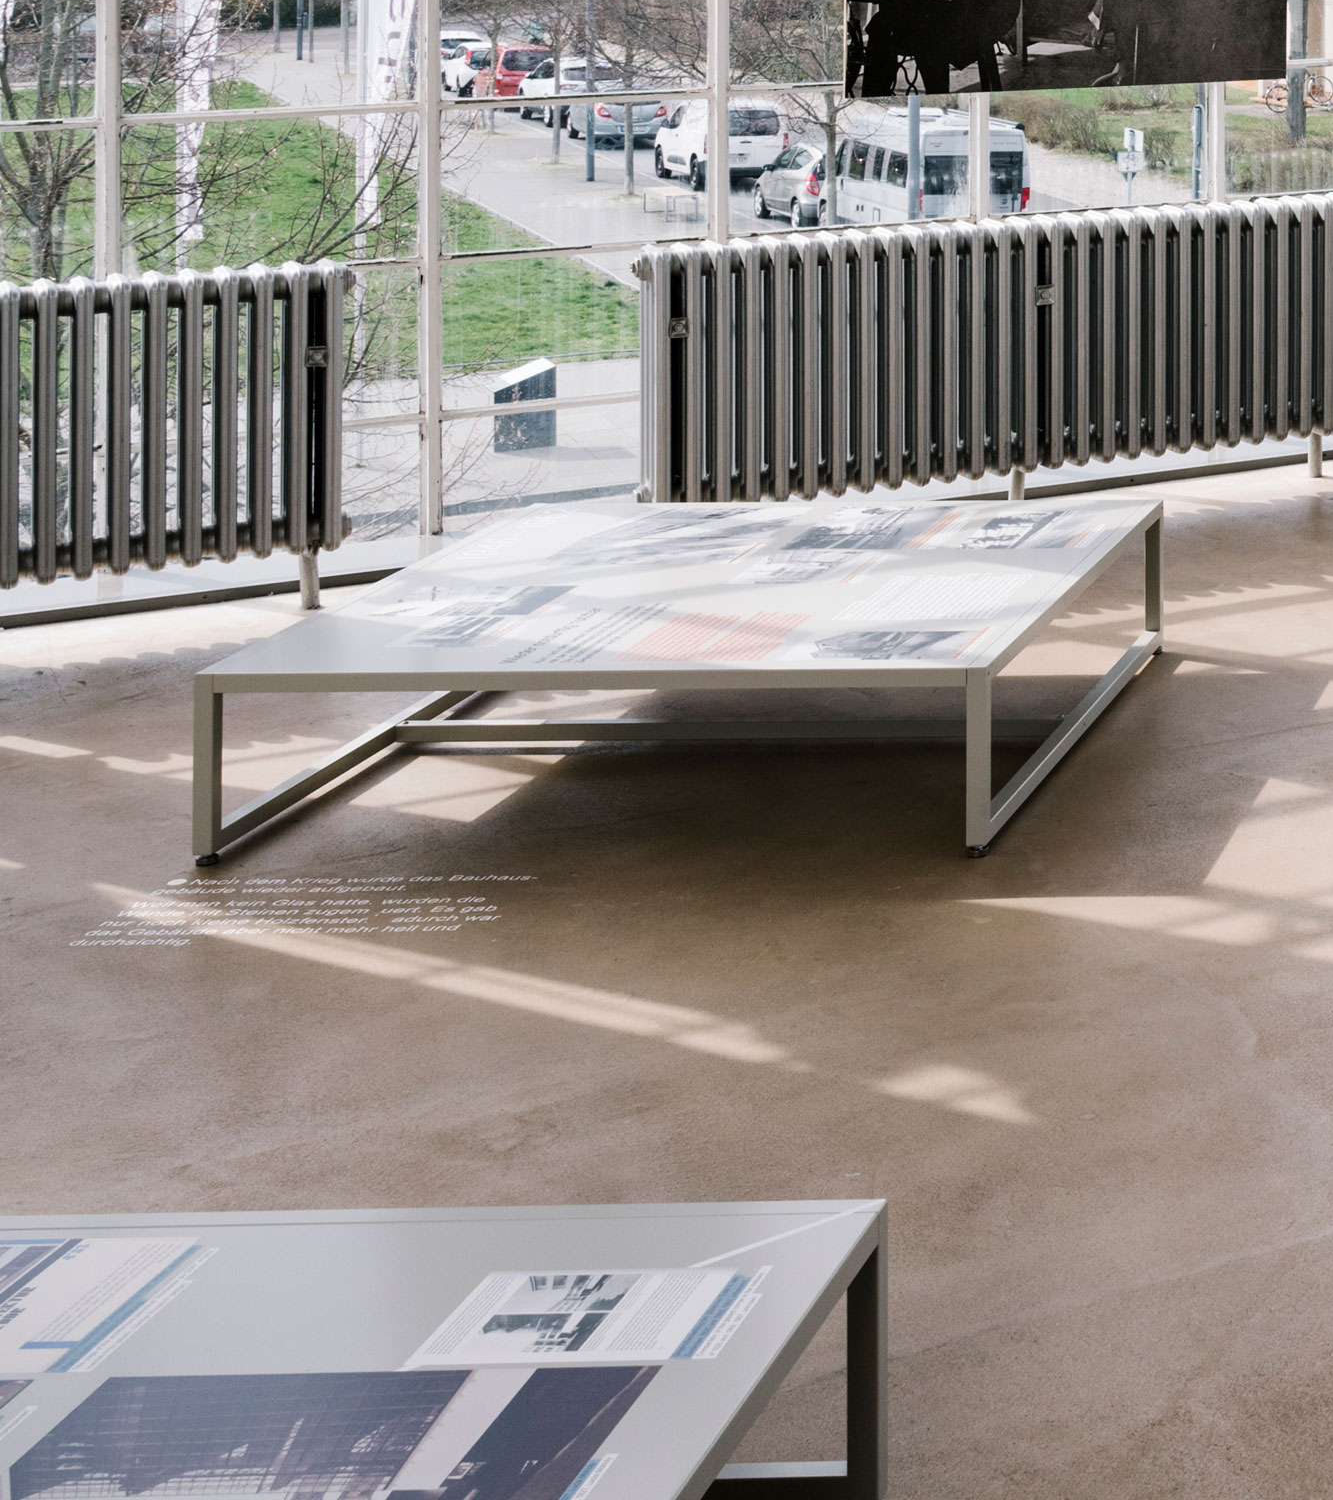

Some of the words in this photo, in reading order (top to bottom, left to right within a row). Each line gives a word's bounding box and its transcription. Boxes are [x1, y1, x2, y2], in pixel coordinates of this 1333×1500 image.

[190, 876, 240, 886] Nach
[245, 877, 287, 886] dem
[291, 876, 342, 887] Krieg
[347, 875, 404, 884] wurde
[409, 875, 444, 883] das
[449, 874, 538, 883] Bauhaus-
[150, 886, 236, 896] gebäude
[242, 885, 305, 894] wieder
[309, 885, 407, 894] aufgebaut.
[132, 900, 177, 909] Weil
[225, 899, 266, 908] kein
[272, 899, 316, 907] Glas
[381, 897, 451, 905] wurden
[457, 895, 486, 903] die
[118, 908, 184, 917] Wände
[189, 908, 223, 916] mit
[226, 907, 300, 916] Steinen
[430, 905, 457, 913] Es
[459, 904, 498, 914] gab
[138, 918, 187, 927] noch
[191, 918, 250, 926] kleine
[255, 916, 369, 925] Holzfenster.
[84, 929, 121, 937] das
[127, 927, 217, 936] Gebäude
[222, 926, 271, 935] aber
[273, 925, 321, 934] nicht
[325, 925, 379, 933] mehr
[381, 924, 419, 932] hell
[422, 923, 462, 932] und
[68, 937, 191, 947] durchsichtig.
